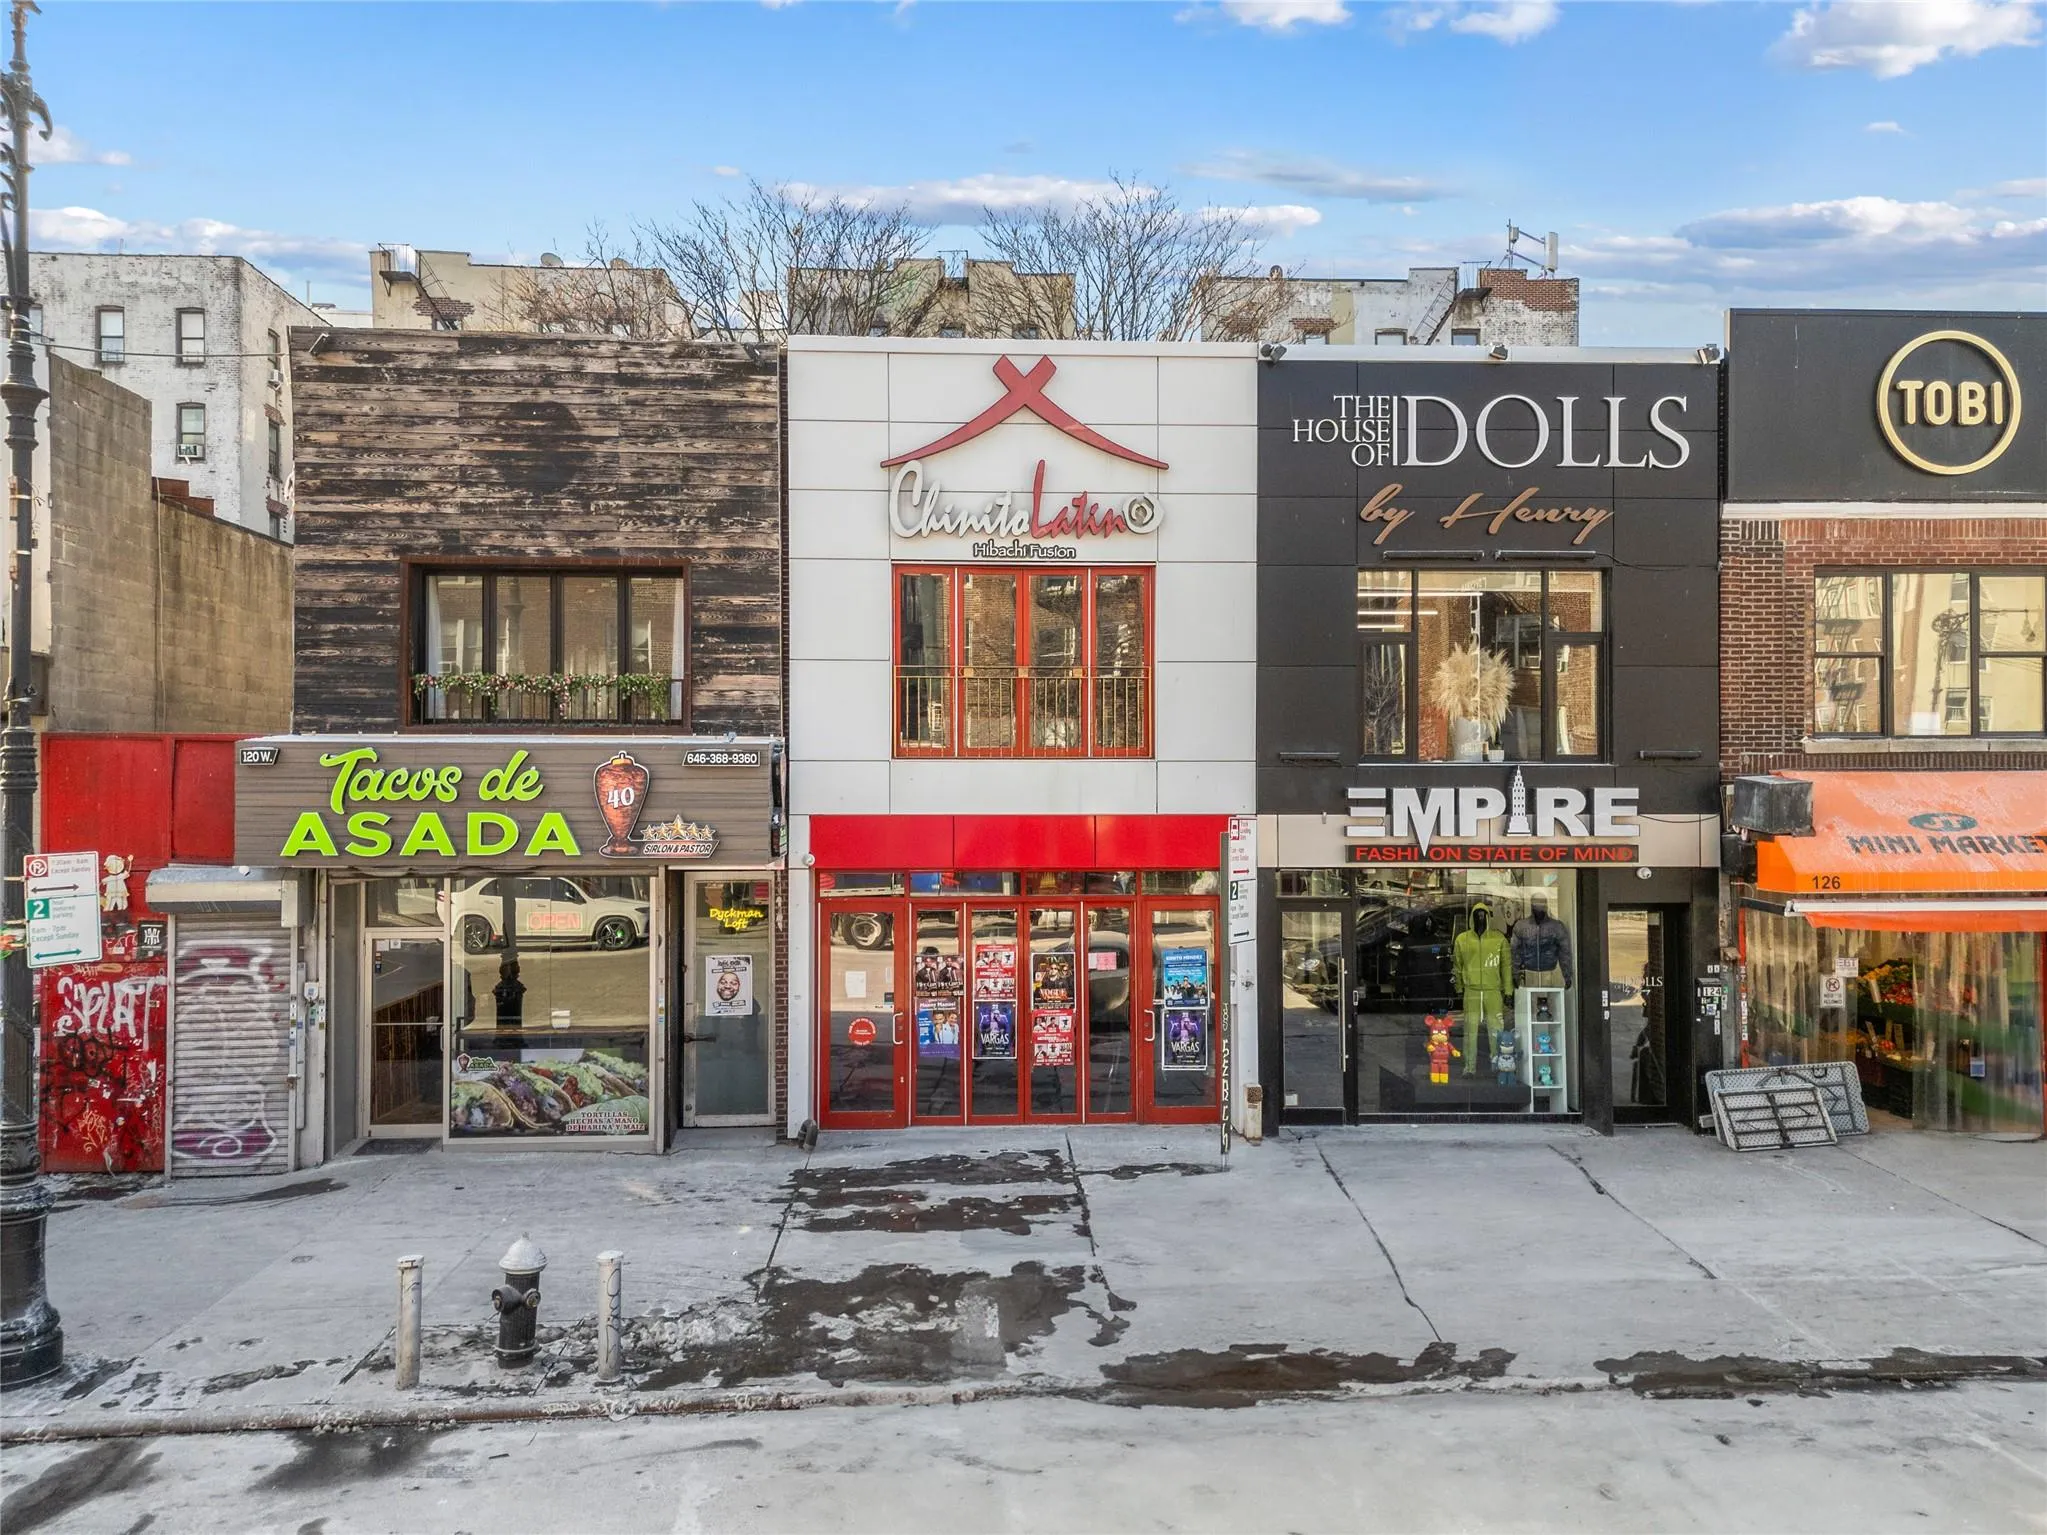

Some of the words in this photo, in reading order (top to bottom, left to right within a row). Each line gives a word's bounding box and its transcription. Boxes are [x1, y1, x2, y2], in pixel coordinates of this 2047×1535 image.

[1334, 395, 1391, 419] THE
[1896, 380, 2004, 426] TOBI
[1292, 418, 1391, 443] HOUSE
[1401, 394, 1691, 470] DOLLS
[1351, 442, 1390, 467] OF
[1359, 483, 1416, 546] by
[1438, 486, 1616, 546] Henry
[973, 539, 1027, 558] Hibachi
[1031, 545, 1077, 559] Fusion
[242, 751, 260, 763] 120
[686, 753, 758, 764] 646-368-9360
[319, 746, 463, 816] Tacos
[606, 787, 635, 809] 40
[1346, 768, 1640, 856] EMPIRE
[279, 811, 582, 857] ASADA
[1467, 846, 1532, 862] STATE
[1538, 846, 1571, 862] OF
[1573, 846, 1633, 862] MIND
[1847, 836, 1921, 854] MINI
[1231, 882, 1237, 899] 2
[1811, 876, 1841, 890] 126
[33, 900, 45, 918] 2
[710, 908, 763, 920] Dyckman
[529, 913, 579, 929] OPEN
[724, 918, 749, 930] Loft
[1704, 986, 1721, 996] 124
[980, 1033, 1010, 1045] VARGAS
[1170, 1041, 1200, 1053] VARGAS
